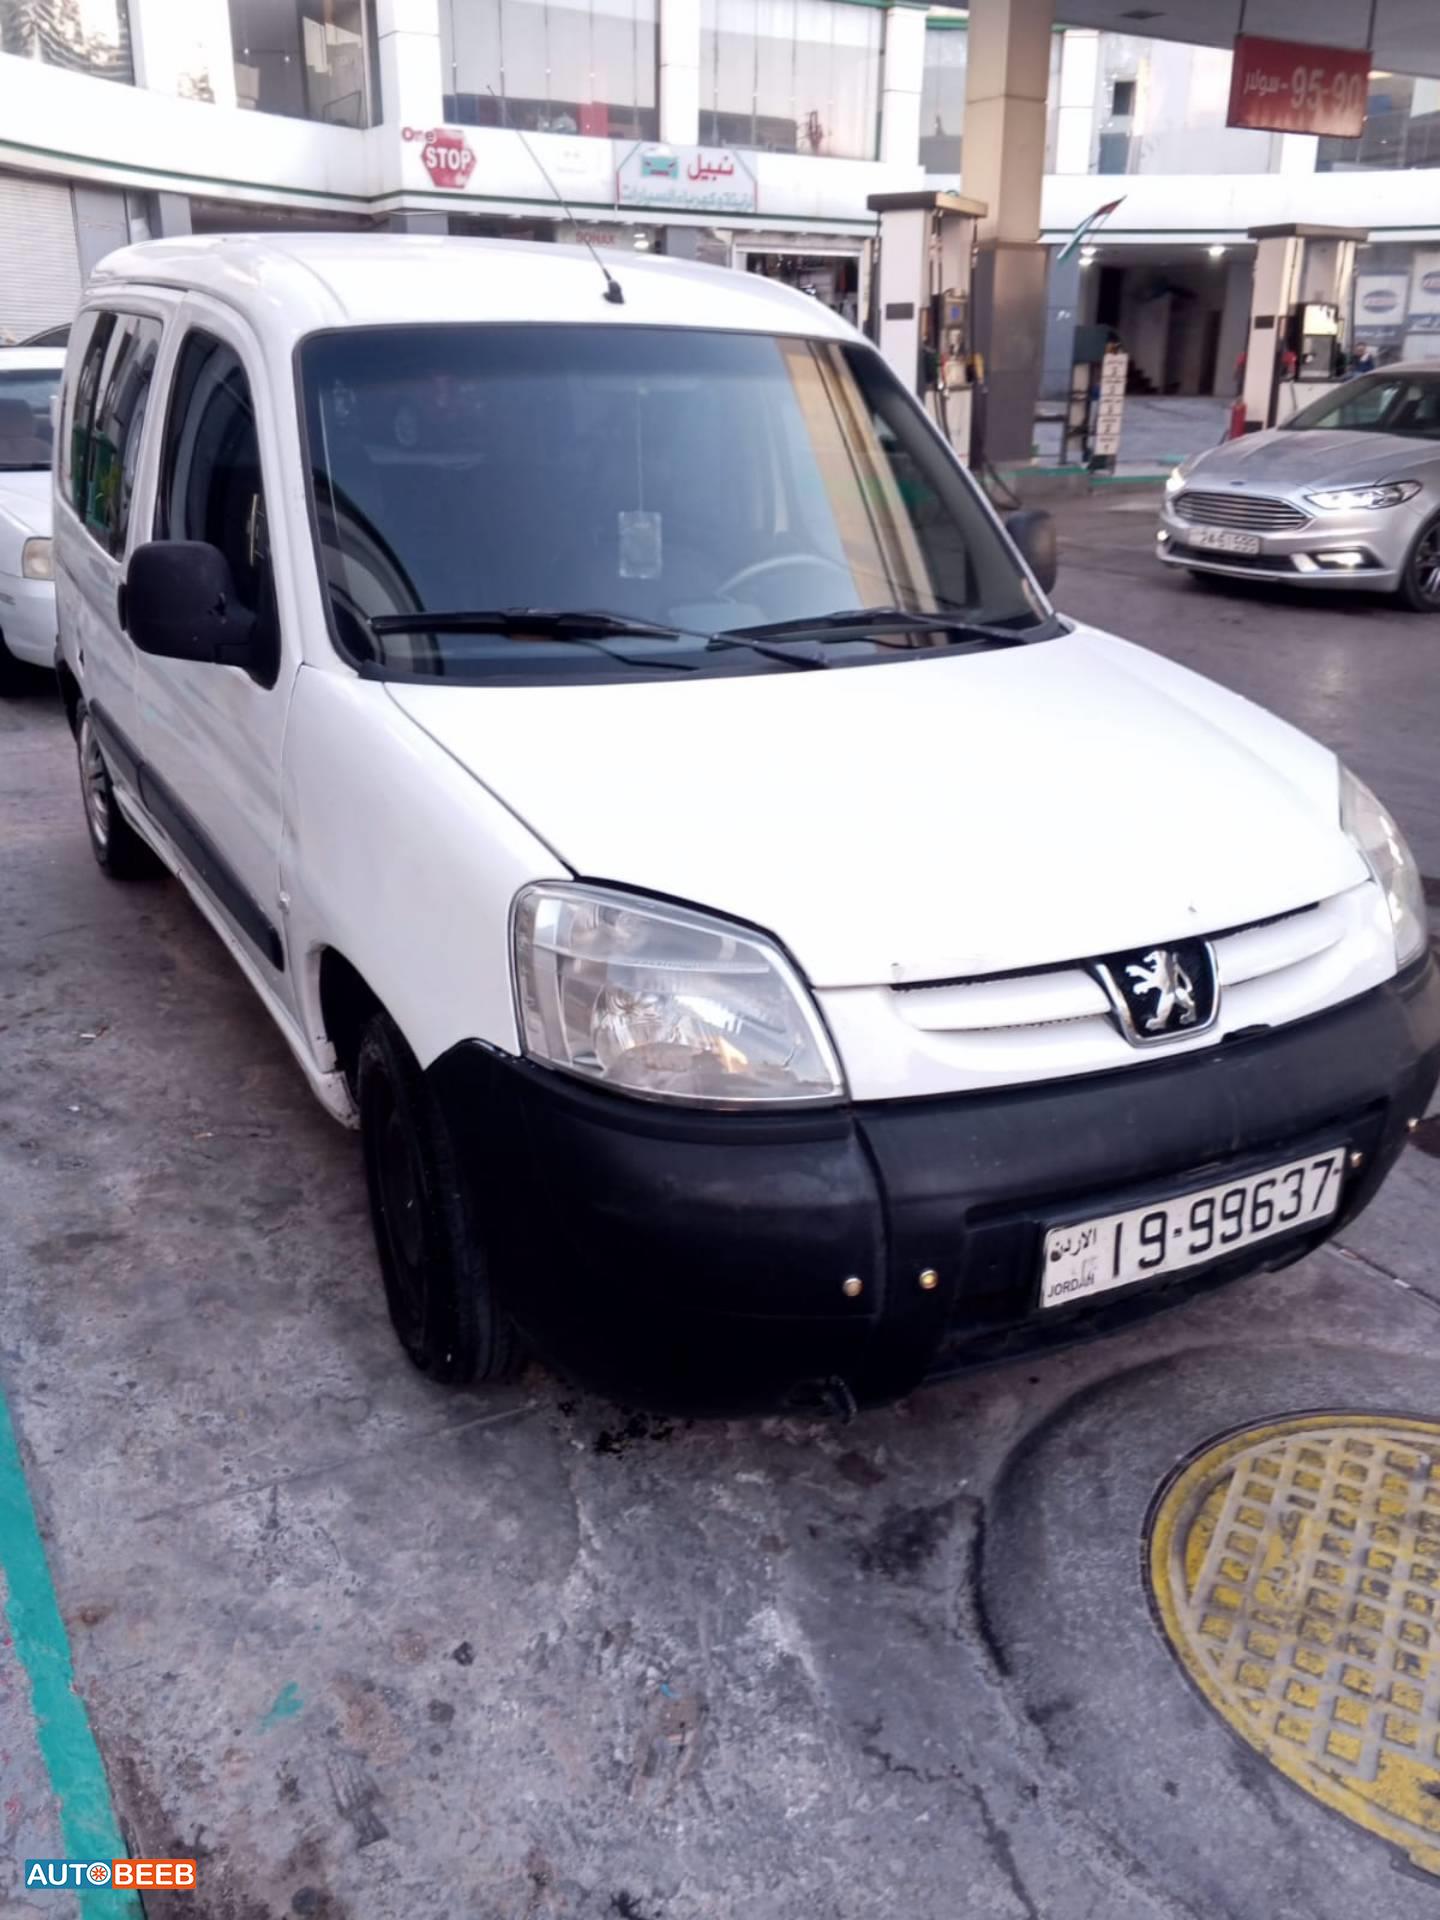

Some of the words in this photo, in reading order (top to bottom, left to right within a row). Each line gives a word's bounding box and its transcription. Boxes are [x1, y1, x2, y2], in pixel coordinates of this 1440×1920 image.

[425, 146, 471, 171] STOP
[687, 153, 735, 181] نبيل
[1112, 1157, 1337, 1279] 19-99637
[1047, 1273, 1095, 1298] JORDAN
